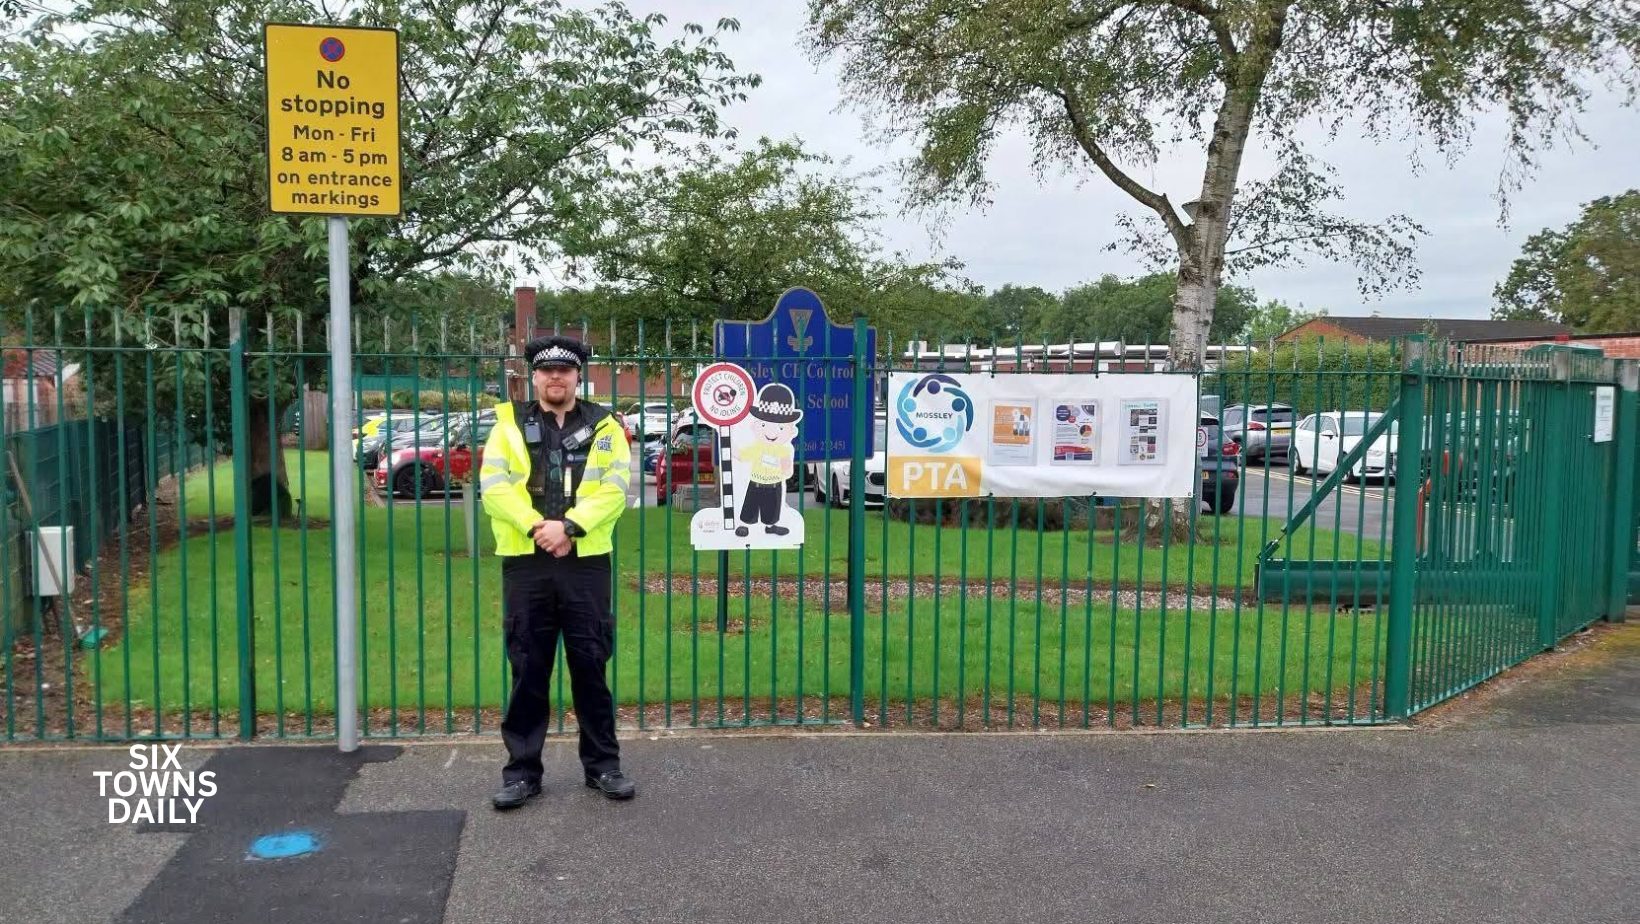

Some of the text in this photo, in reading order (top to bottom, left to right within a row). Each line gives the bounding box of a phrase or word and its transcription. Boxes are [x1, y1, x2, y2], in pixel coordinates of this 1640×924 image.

[317, 70, 350, 89] No
[281, 95, 385, 119] stopping
[293, 124, 334, 141] Mon
[351, 127, 375, 142] Fri
[281, 147, 293, 161] 8
[299, 151, 326, 163] am
[343, 149, 354, 163] 5
[360, 152, 387, 167] pm
[277, 171, 392, 187] on entrance
[291, 190, 379, 208] markings
[903, 461, 968, 490] PTA
